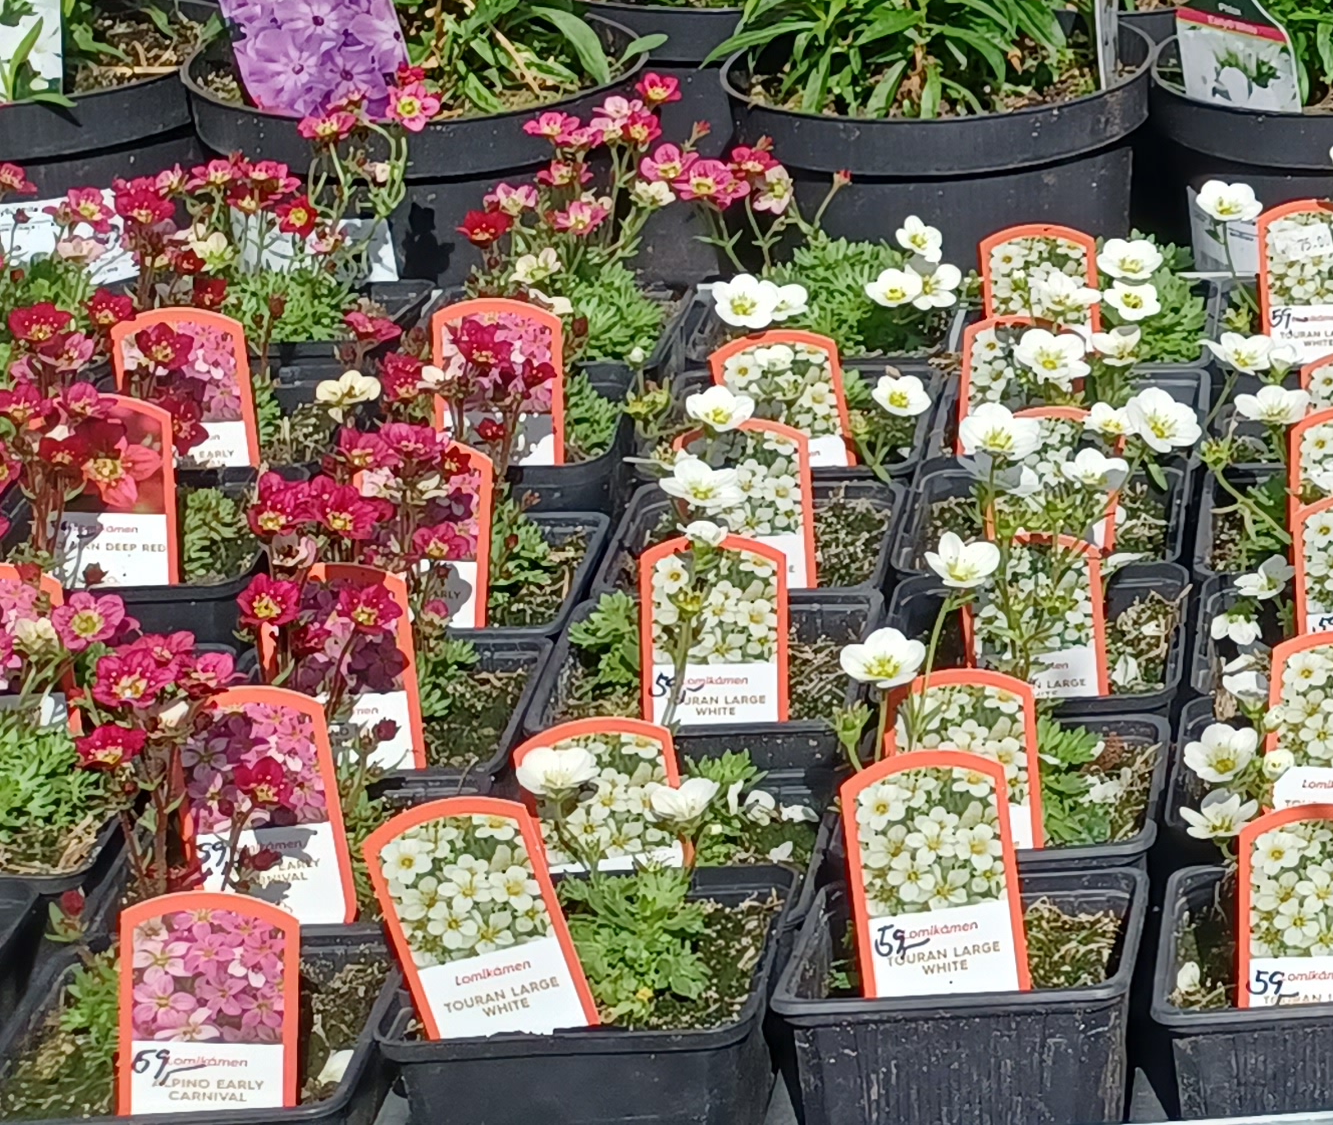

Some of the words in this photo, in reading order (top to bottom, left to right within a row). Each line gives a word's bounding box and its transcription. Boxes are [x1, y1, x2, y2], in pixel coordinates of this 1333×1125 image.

[105, 542, 138, 552] DEEP
[142, 543, 166, 553] RED
[433, 590, 462, 600] ARLY
[686, 676, 749, 685] omikámen
[1047, 678, 1087, 689] LARGE
[724, 695, 766, 704] LARGE
[695, 707, 736, 716] WHITE
[887, 948, 948, 967] TOURAN
[953, 941, 1001, 957] LARGE
[922, 959, 969, 975] WHITE
[455, 960, 532, 987] Lomikámen
[443, 989, 506, 1013] TOURAN
[510, 976, 560, 997] LARGE
[482, 997, 530, 1017] WHITE
[216, 1079, 264, 1090] EARLY
[168, 1091, 247, 1102] CARNIVAL
